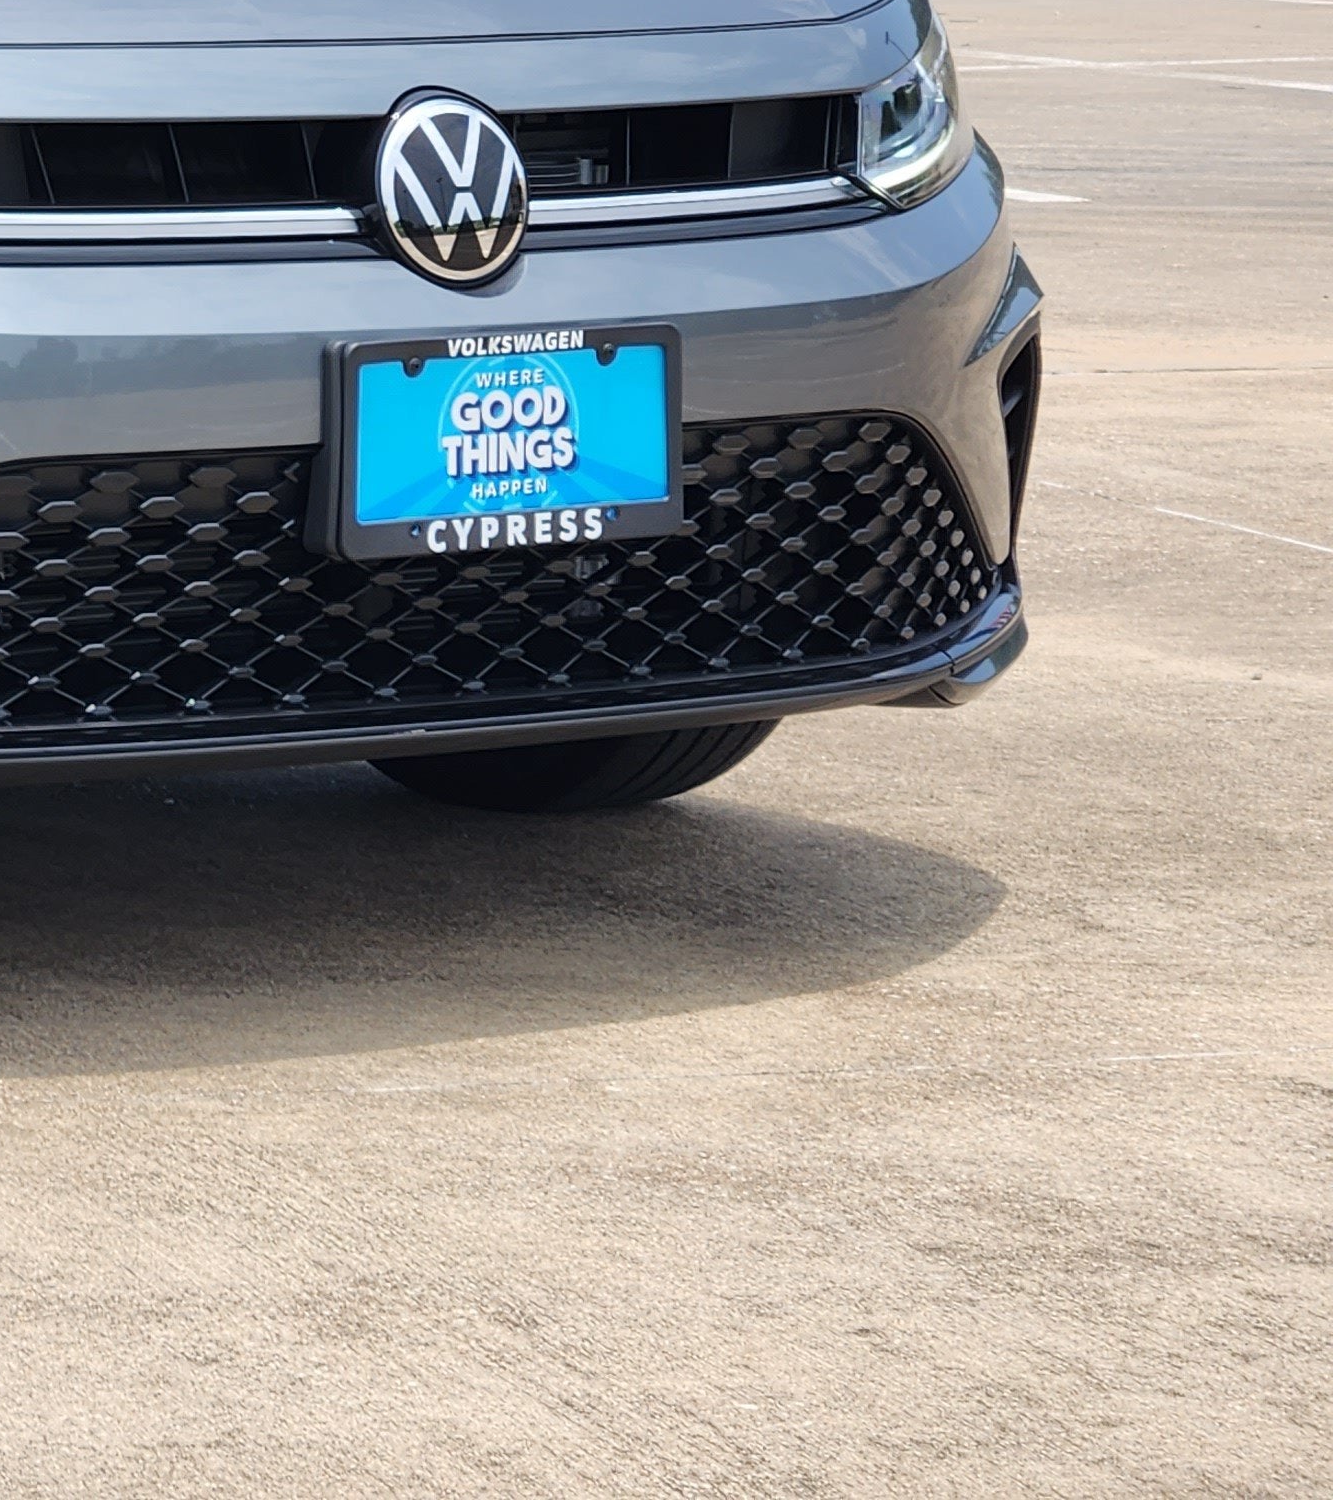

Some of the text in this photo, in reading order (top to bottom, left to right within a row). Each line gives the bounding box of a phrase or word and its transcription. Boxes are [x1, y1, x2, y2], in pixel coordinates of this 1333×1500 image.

[447, 329, 585, 358] VOLKSWAGEN
[475, 368, 545, 389] WHERE
[450, 385, 567, 433] GOOD
[441, 426, 575, 477] THINGS
[472, 478, 549, 499] HAPPEN
[426, 507, 603, 554] CYPRESS
